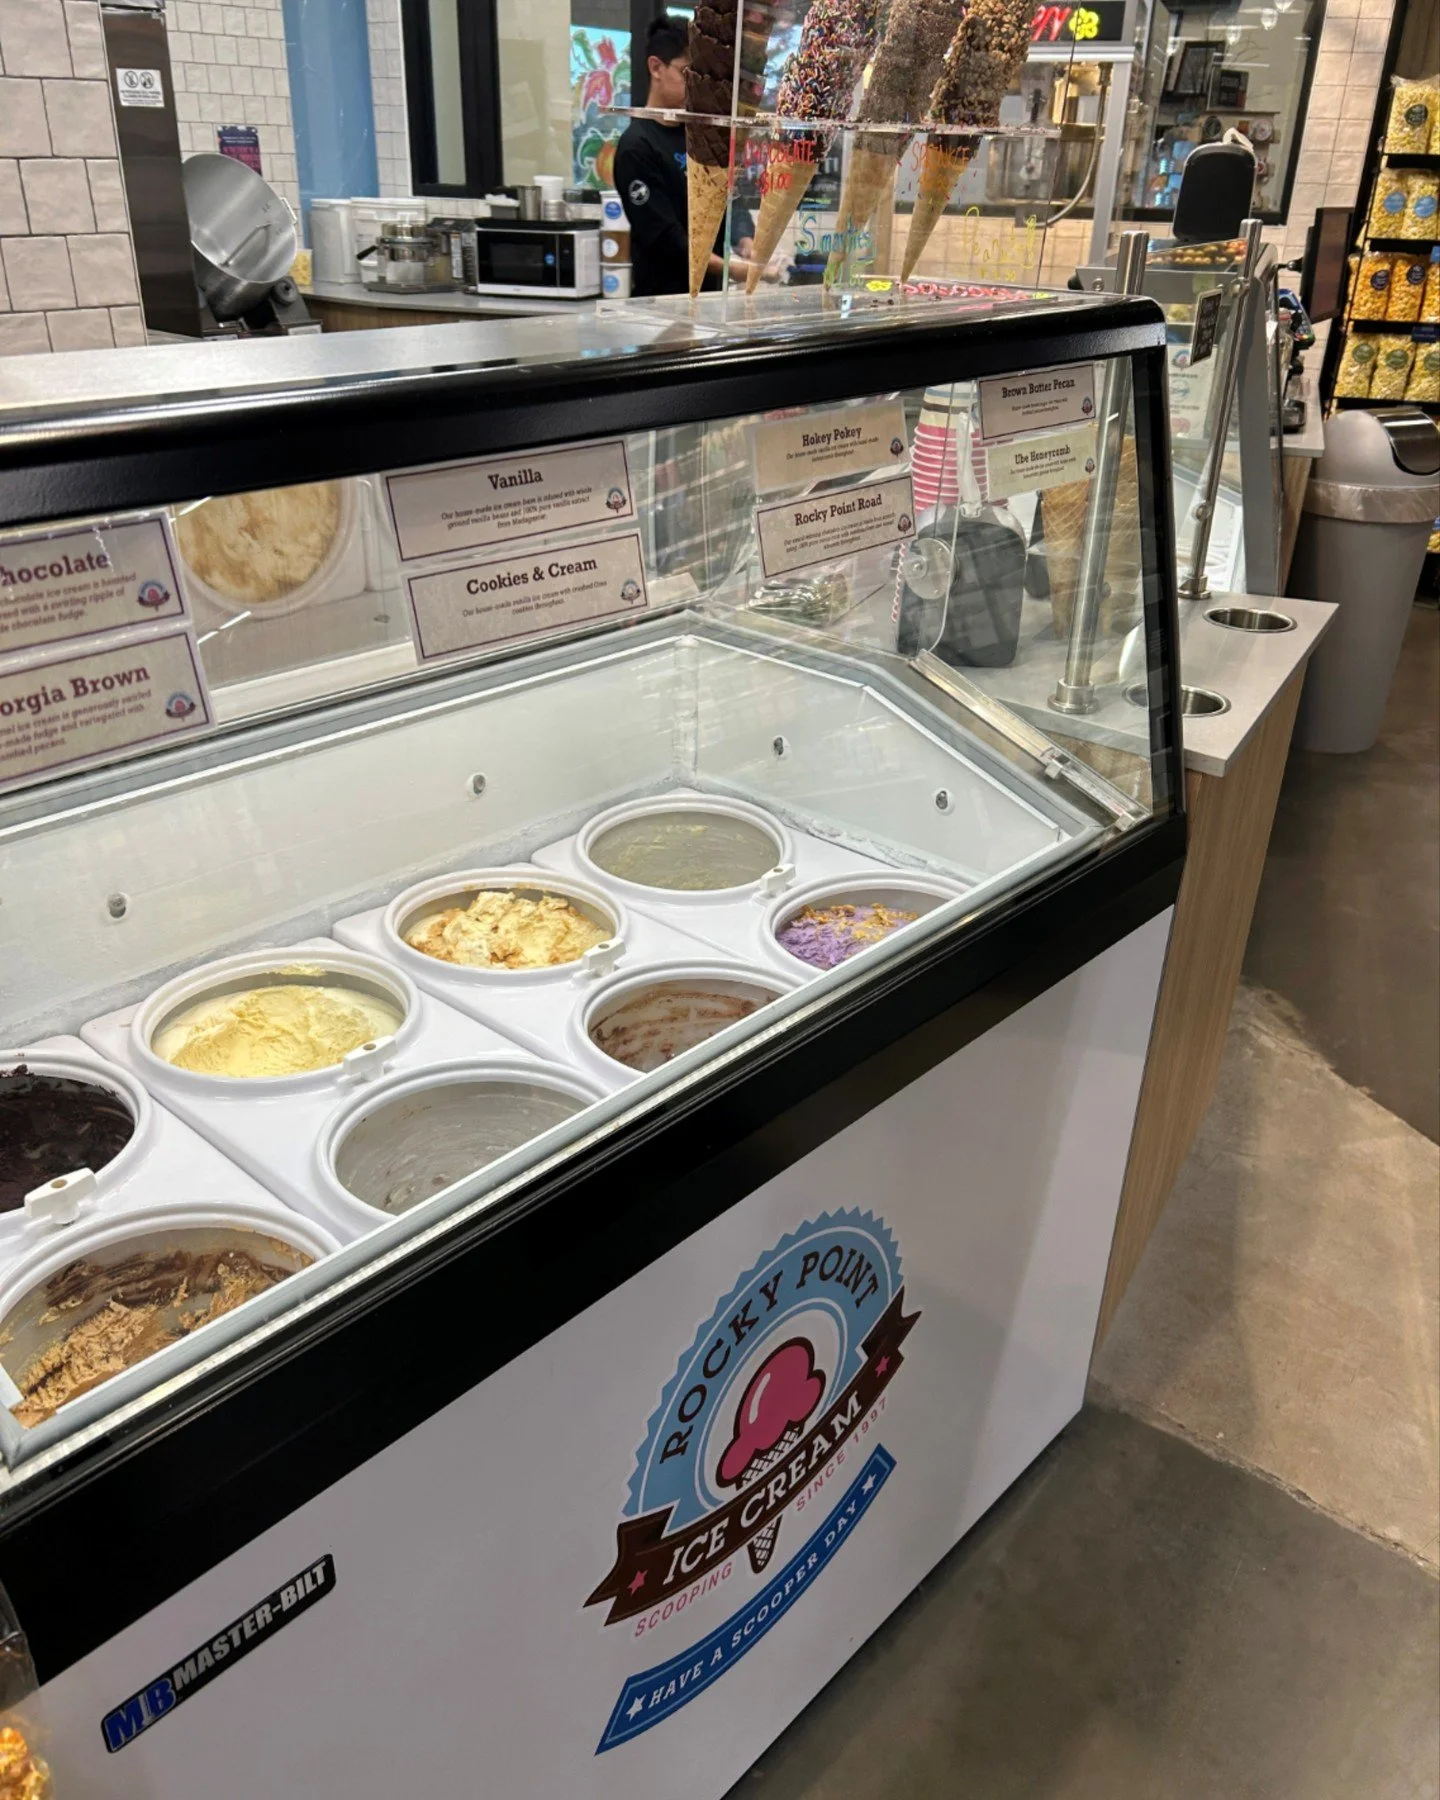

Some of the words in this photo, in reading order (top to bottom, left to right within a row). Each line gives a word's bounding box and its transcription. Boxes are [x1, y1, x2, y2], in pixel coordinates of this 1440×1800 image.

[1002, 386, 1027, 398] Brown
[1029, 383, 1052, 394] Butter
[1053, 379, 1075, 390] Pecan
[802, 433, 832, 447] Hokey
[834, 426, 862, 441] Pokey
[1014, 453, 1029, 464] Ube
[1030, 444, 1071, 461] Honeycomb
[488, 468, 543, 490] Vanilla
[794, 508, 827, 527] Rocky
[830, 501, 856, 517] Point
[857, 494, 882, 510] Road
[466, 571, 529, 595] Cookies
[532, 566, 545, 582] &
[548, 557, 598, 579] Cream
[69, 665, 151, 698] Brown
[659, 1270, 783, 1465] ROCKY
[796, 1245, 879, 1309] POINT
[662, 1517, 729, 1586] ICE
[740, 1390, 863, 1528] CREAM
[634, 1561, 733, 1638] SCOOPING
[796, 1451, 846, 1512] SINCE
[852, 1398, 887, 1443] 1997
[648, 1660, 703, 1708] HAVE
[710, 1647, 723, 1667] A
[731, 1552, 818, 1648] SCOOPER
[823, 1499, 857, 1548] DAY
[171, 1561, 327, 1691] MASTER-BILT
